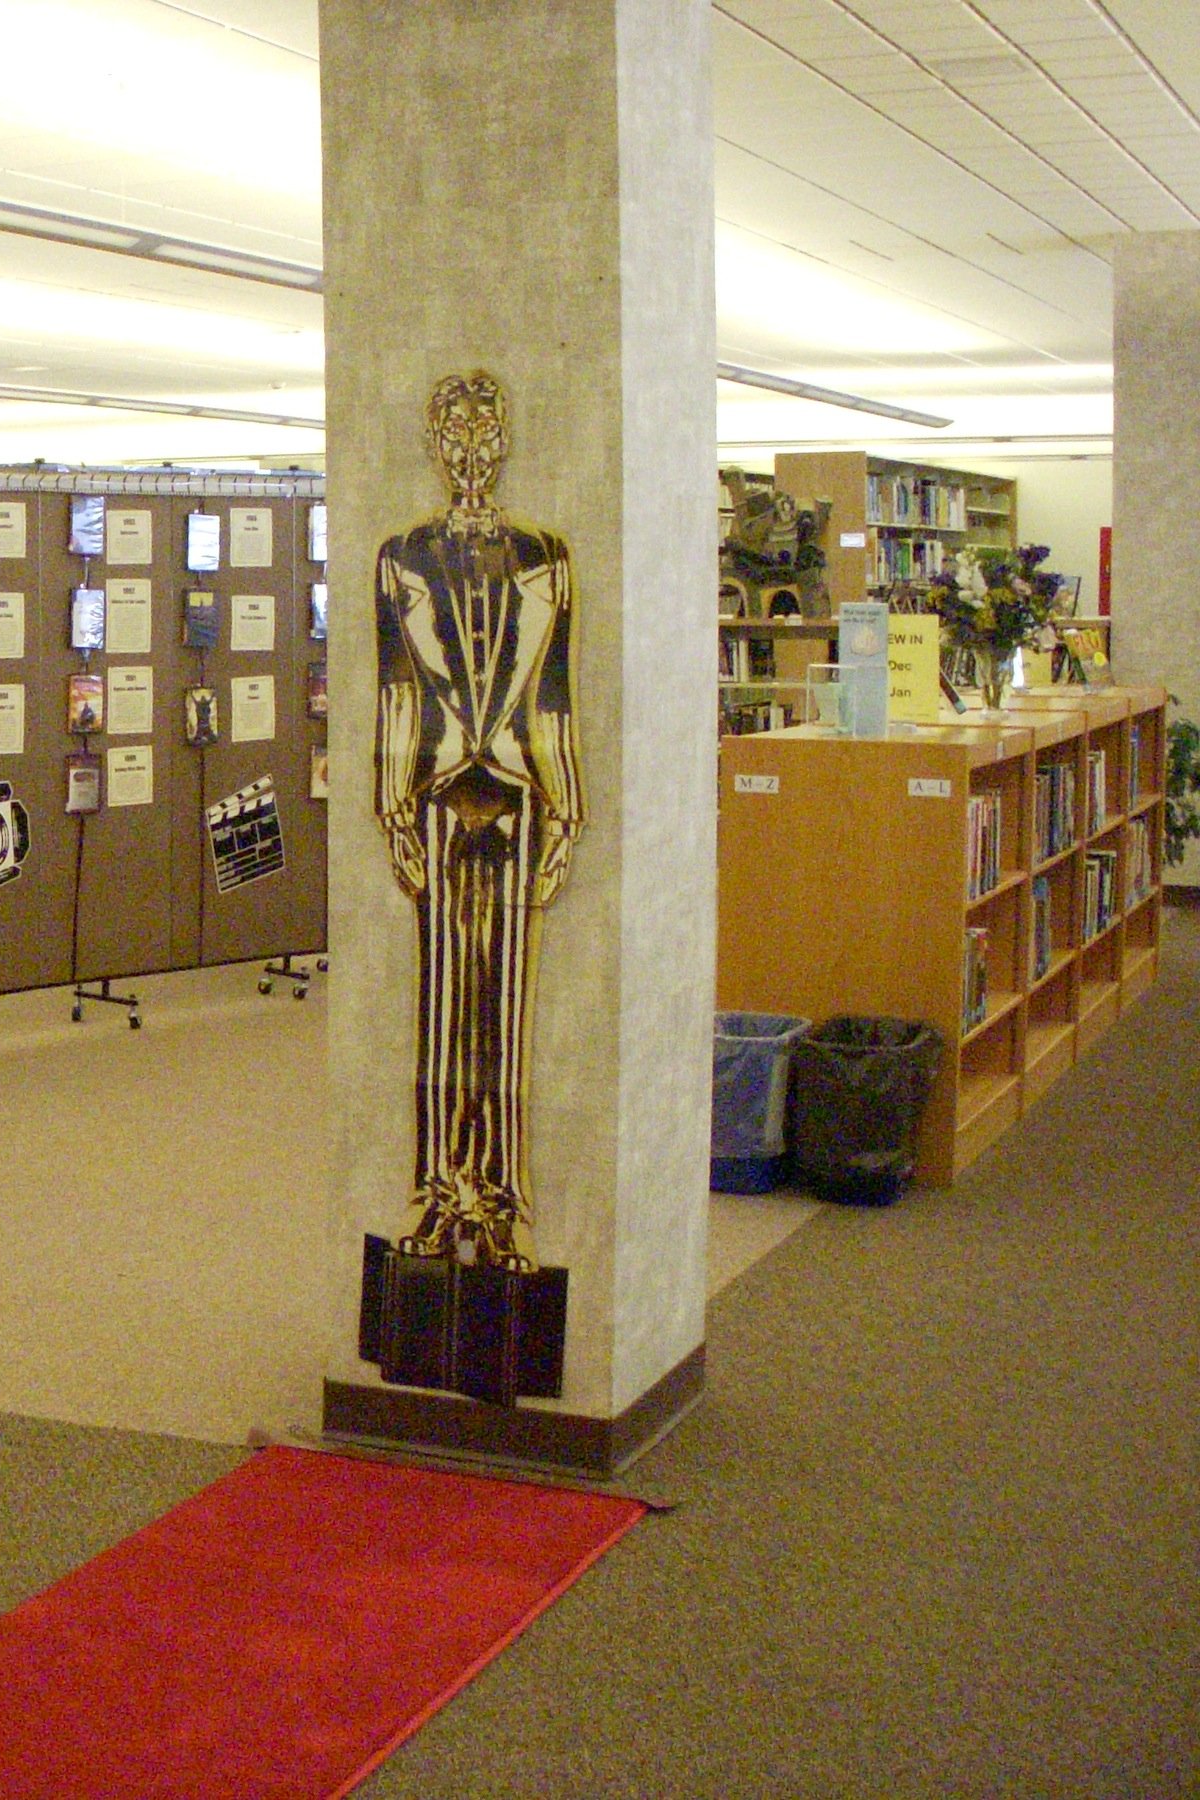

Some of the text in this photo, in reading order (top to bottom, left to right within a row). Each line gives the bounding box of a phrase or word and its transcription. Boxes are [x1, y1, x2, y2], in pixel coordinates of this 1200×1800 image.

[887, 633, 924, 645] EW IN
[888, 660, 912, 671] Dec
[889, 686, 912, 698] Jan
